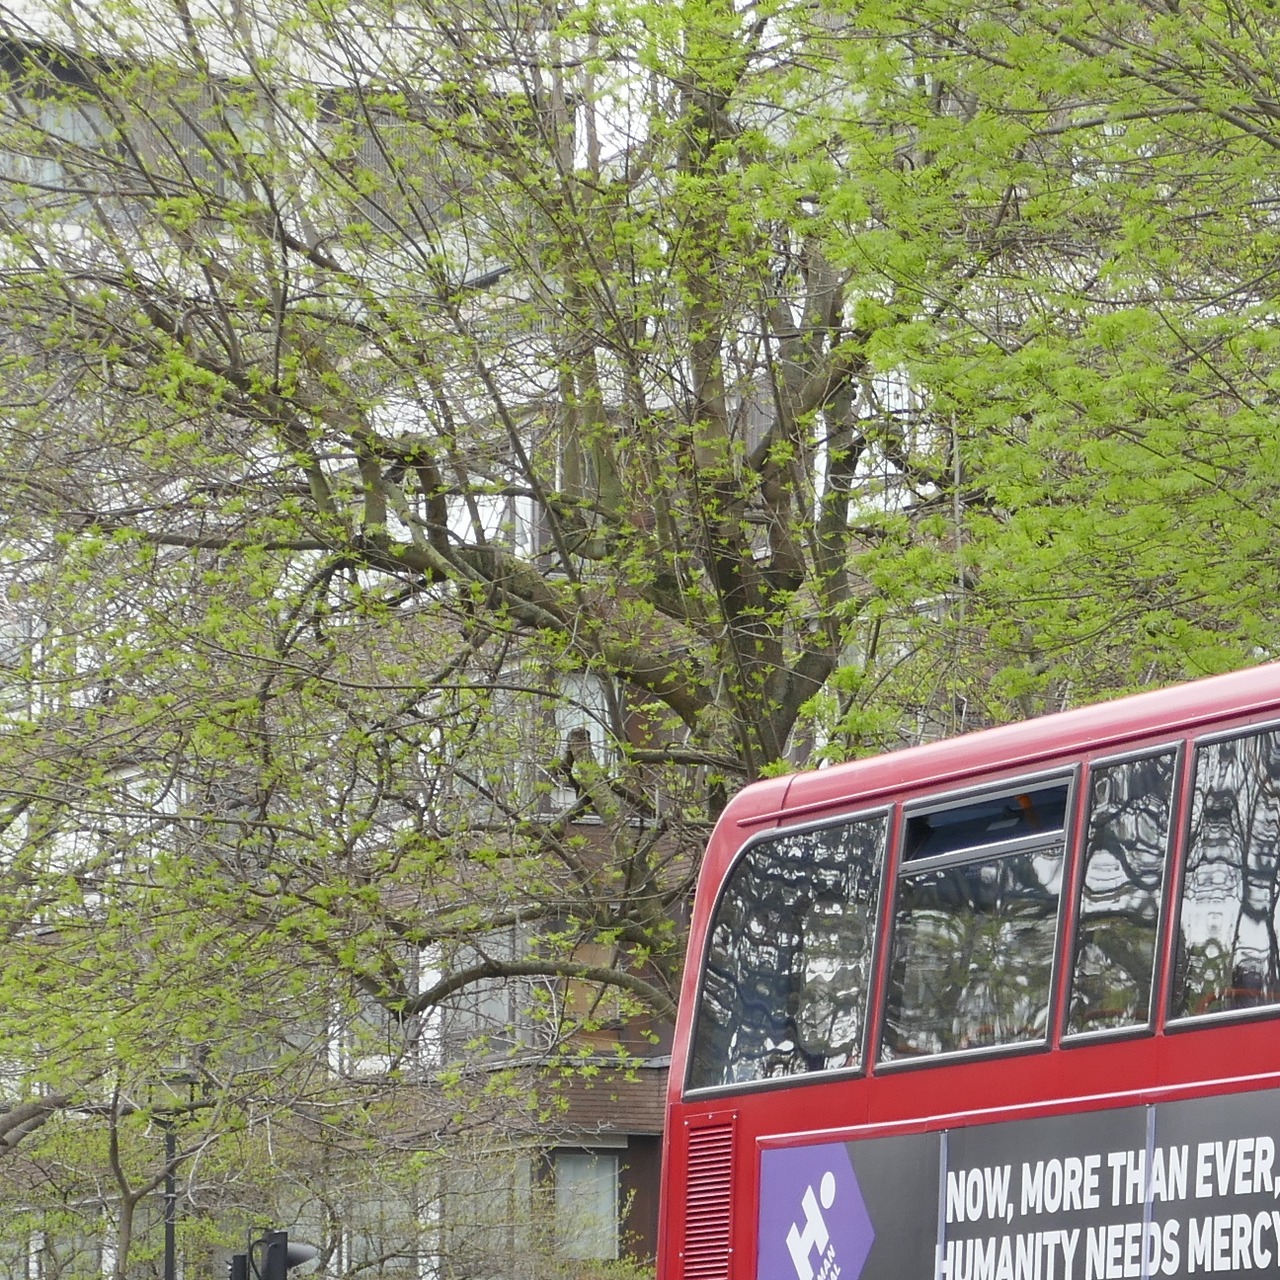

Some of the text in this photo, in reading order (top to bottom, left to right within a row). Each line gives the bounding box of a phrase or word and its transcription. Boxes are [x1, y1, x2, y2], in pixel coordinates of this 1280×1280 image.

[946, 1164, 1014, 1225] NOW,
[1020, 1154, 1102, 1216] MORE
[1107, 1144, 1190, 1207] THAN
